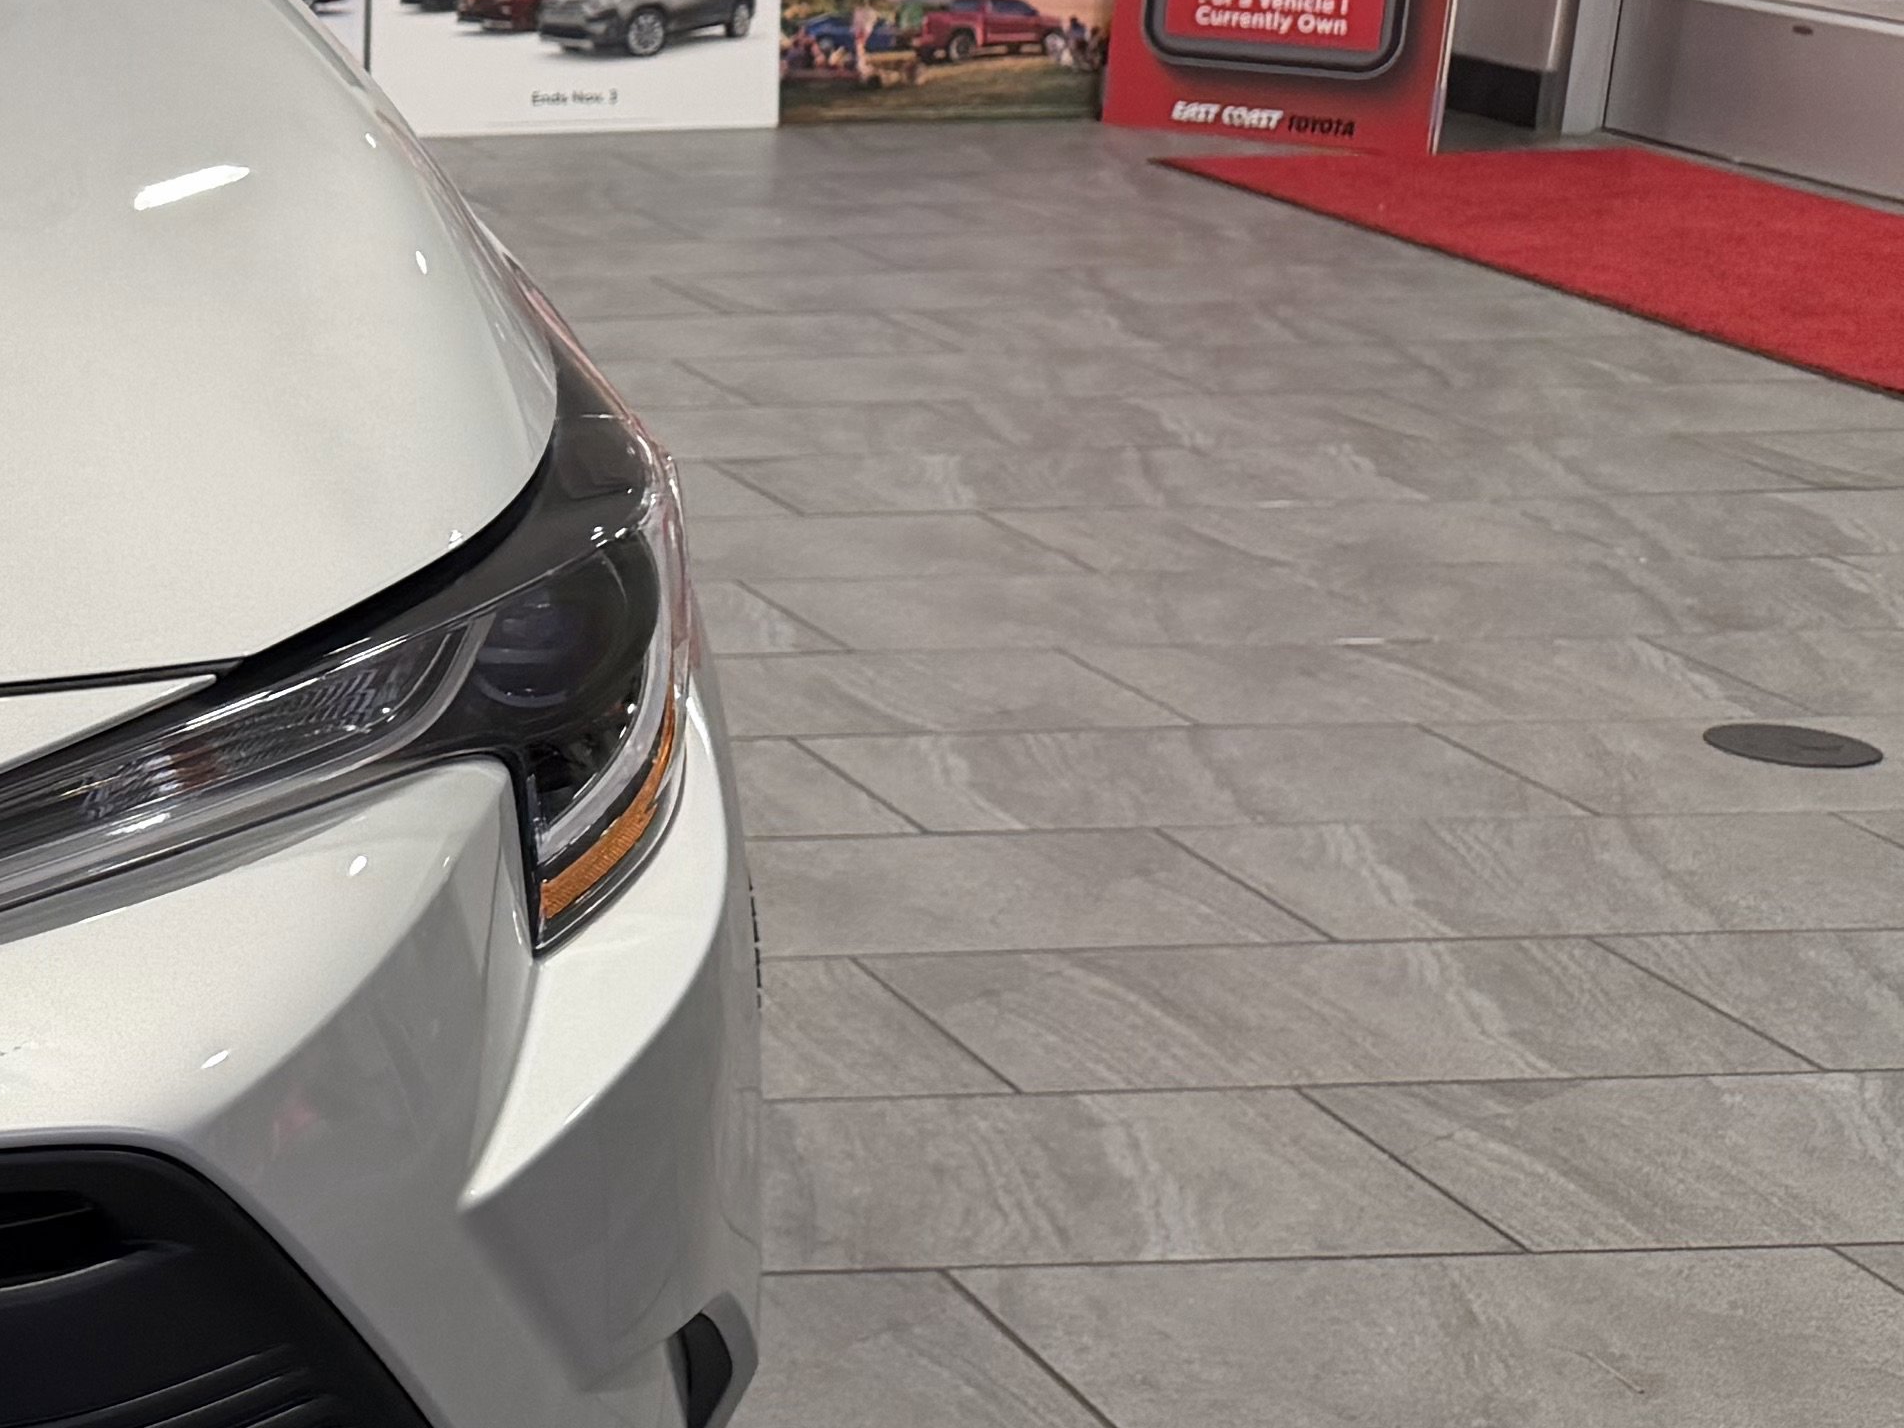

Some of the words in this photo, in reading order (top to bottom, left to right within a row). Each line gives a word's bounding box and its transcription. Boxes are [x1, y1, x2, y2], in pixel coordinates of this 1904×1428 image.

[1195, 4, 1294, 35] Currently
[1297, 13, 1348, 36] Own
[1171, 99, 1222, 124] EAST
[1221, 104, 1285, 130] COAST
[1287, 115, 1356, 138] TOYOTA
